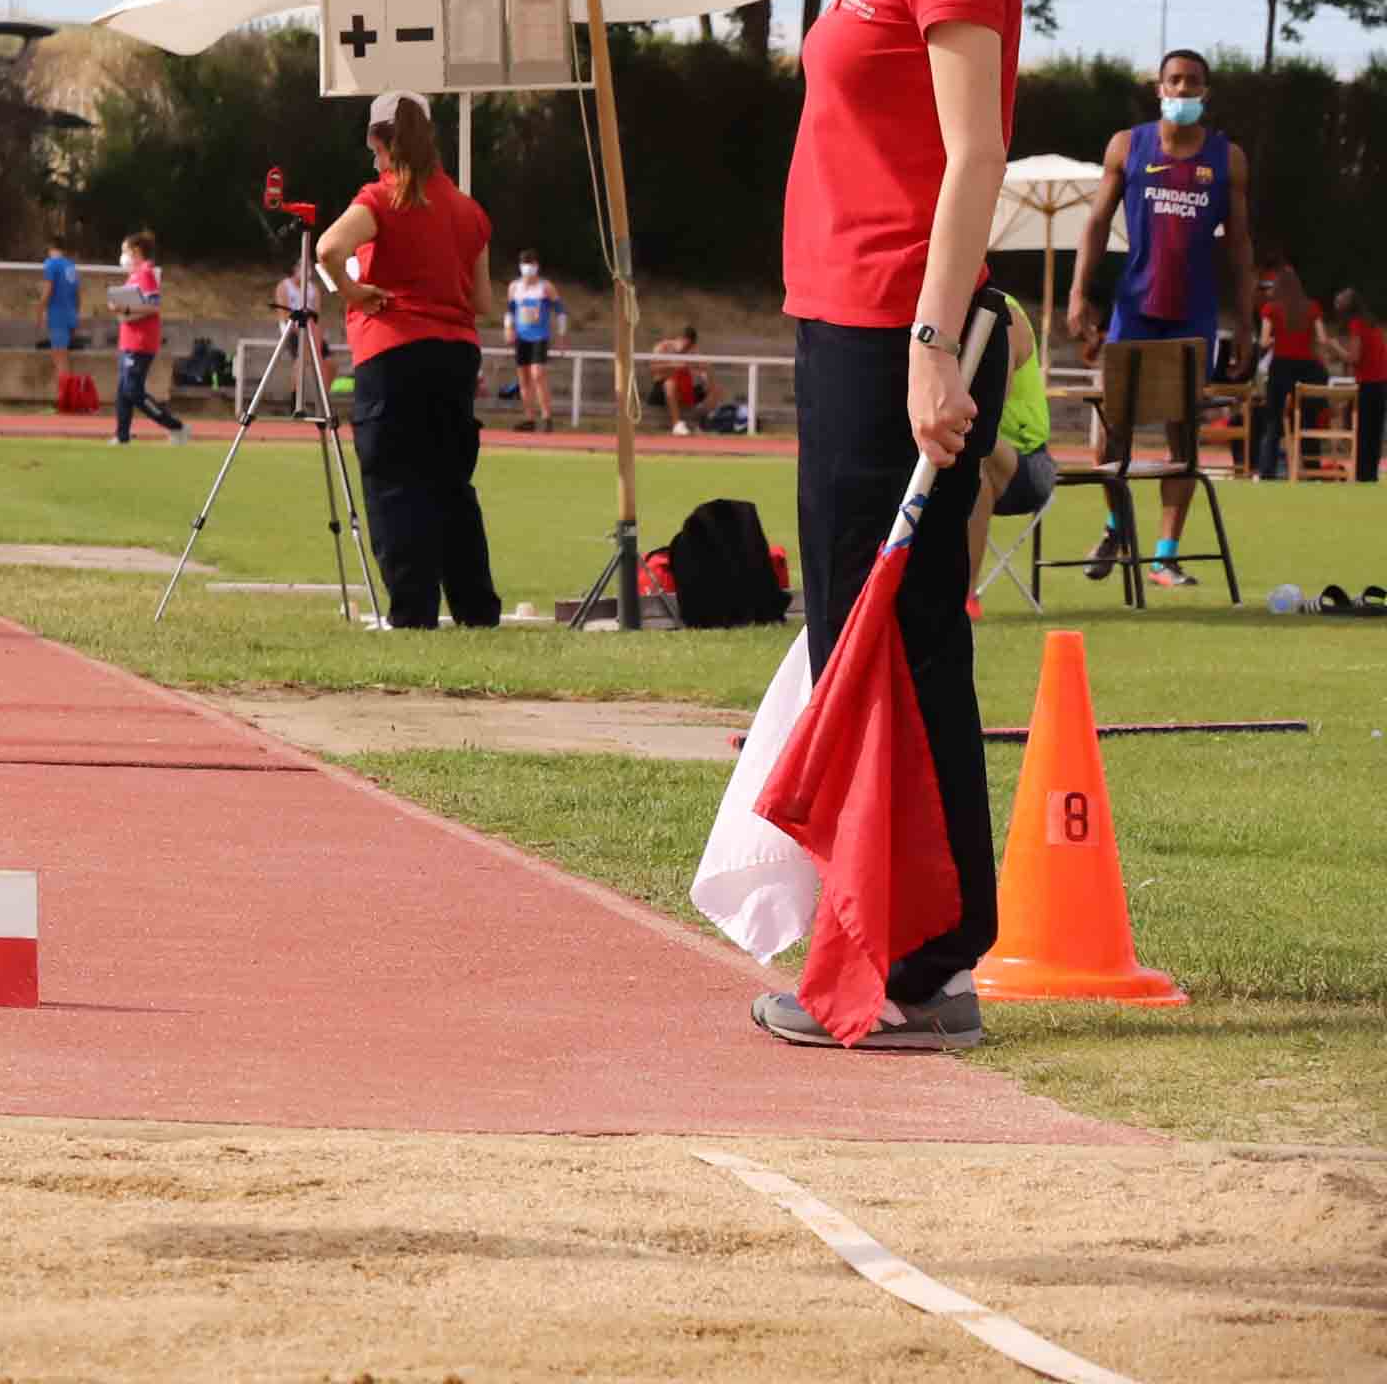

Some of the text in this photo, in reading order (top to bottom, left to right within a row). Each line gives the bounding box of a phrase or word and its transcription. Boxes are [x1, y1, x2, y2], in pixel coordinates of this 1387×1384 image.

[1145, 186, 1209, 207] FUNDACIÓ
[1154, 201, 1196, 218] BARÇA
[1064, 791, 1089, 843] 8
